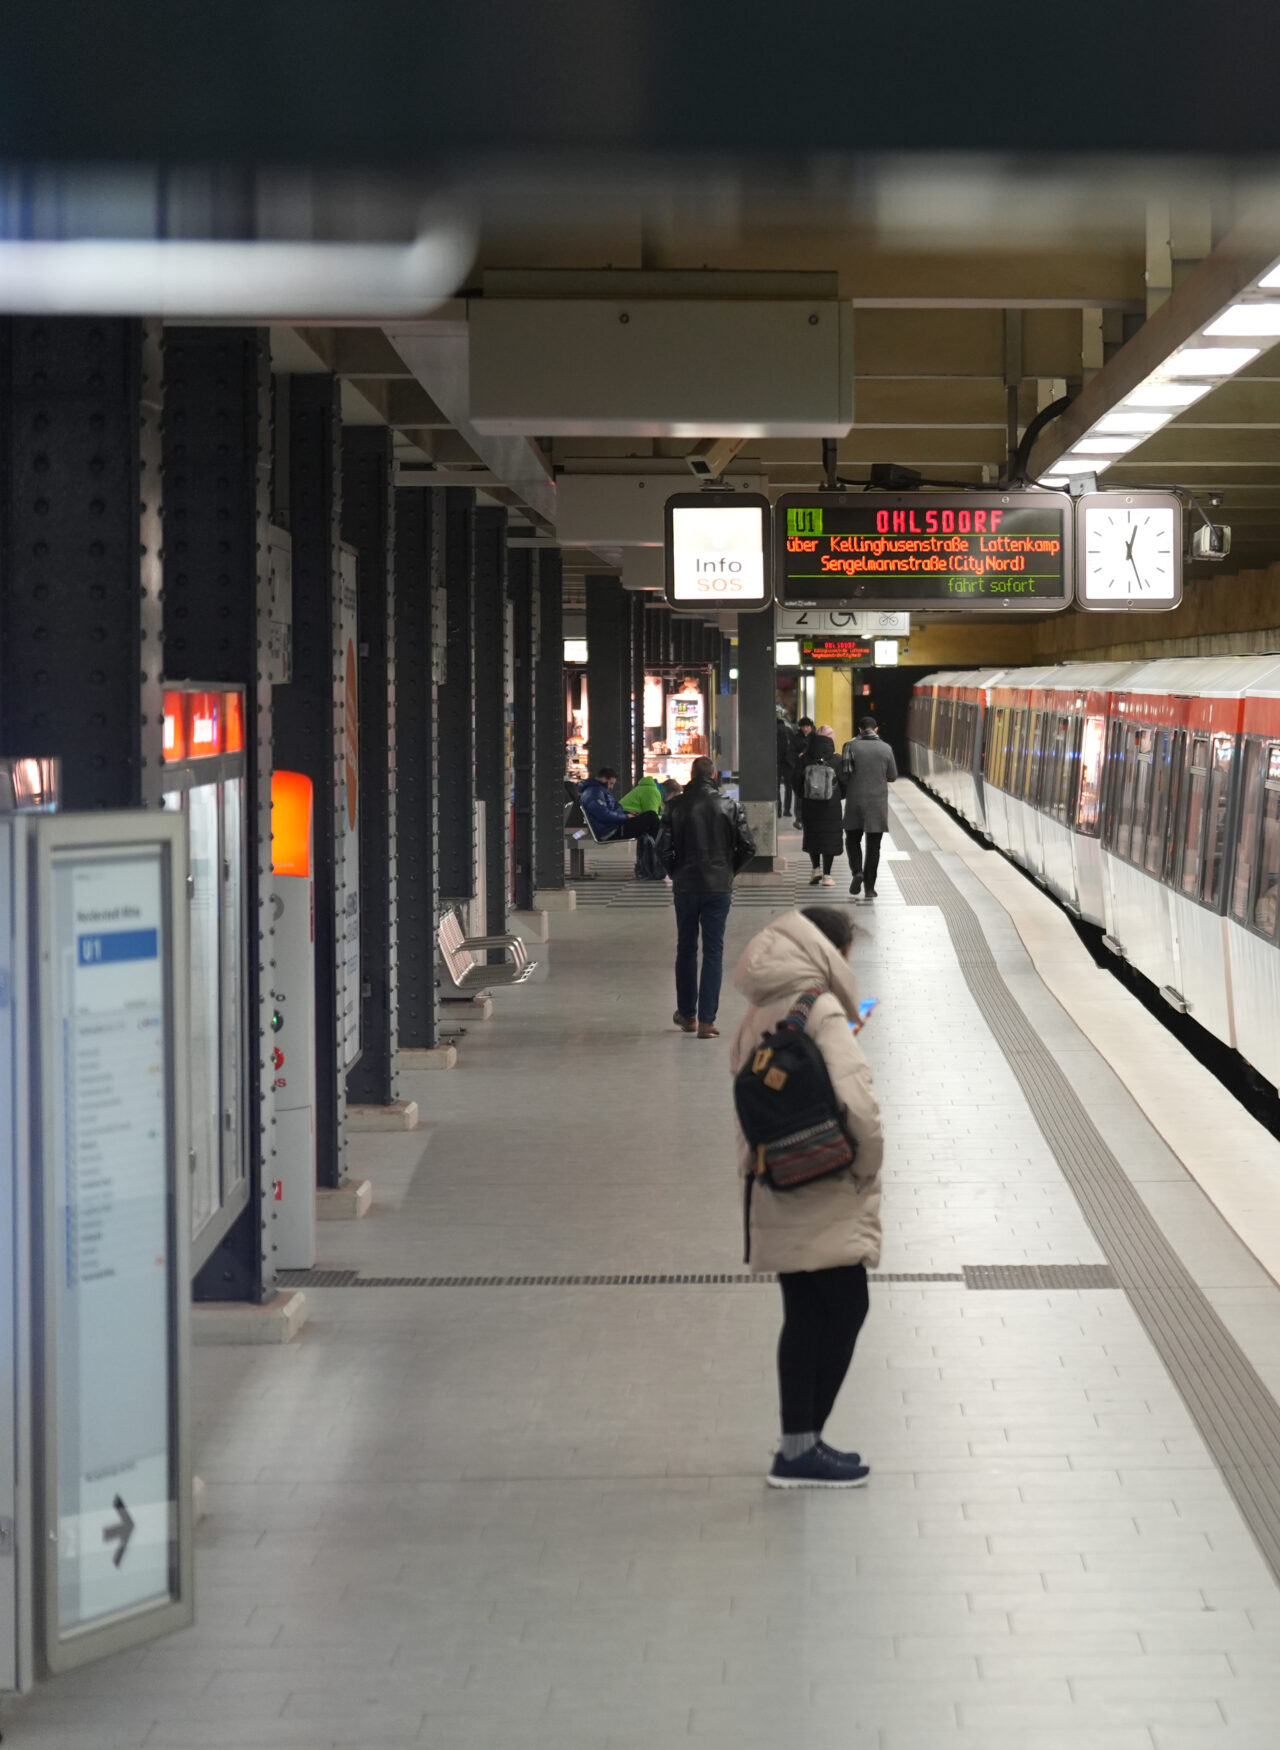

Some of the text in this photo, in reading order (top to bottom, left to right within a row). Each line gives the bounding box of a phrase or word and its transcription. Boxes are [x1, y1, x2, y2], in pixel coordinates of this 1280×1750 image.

[797, 511, 815, 533] U1
[877, 510, 1005, 533] OHLSDORF
[787, 537, 1061, 556] über Kellinghusenstraße Lattenkamp
[696, 557, 742, 573] Info
[696, 578, 743, 592] SOS
[948, 578, 1035, 593] fährt sofort
